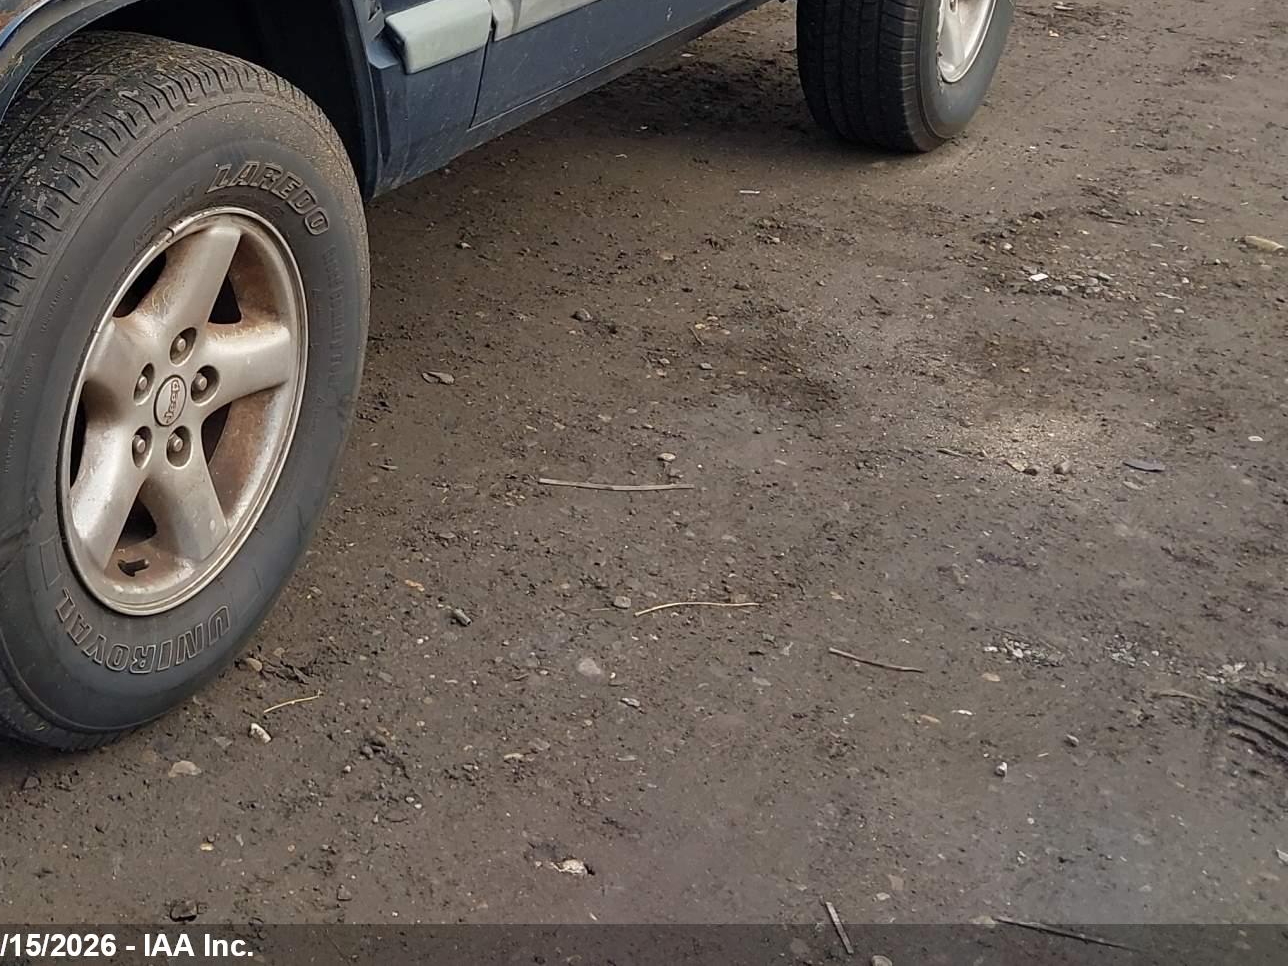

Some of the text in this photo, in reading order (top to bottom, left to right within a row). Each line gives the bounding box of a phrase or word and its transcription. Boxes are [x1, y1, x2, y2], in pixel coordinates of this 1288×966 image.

[204, 160, 330, 236] LAREDO
[164, 379, 180, 424] Jeep
[55, 587, 231, 675] UNIROYAL
